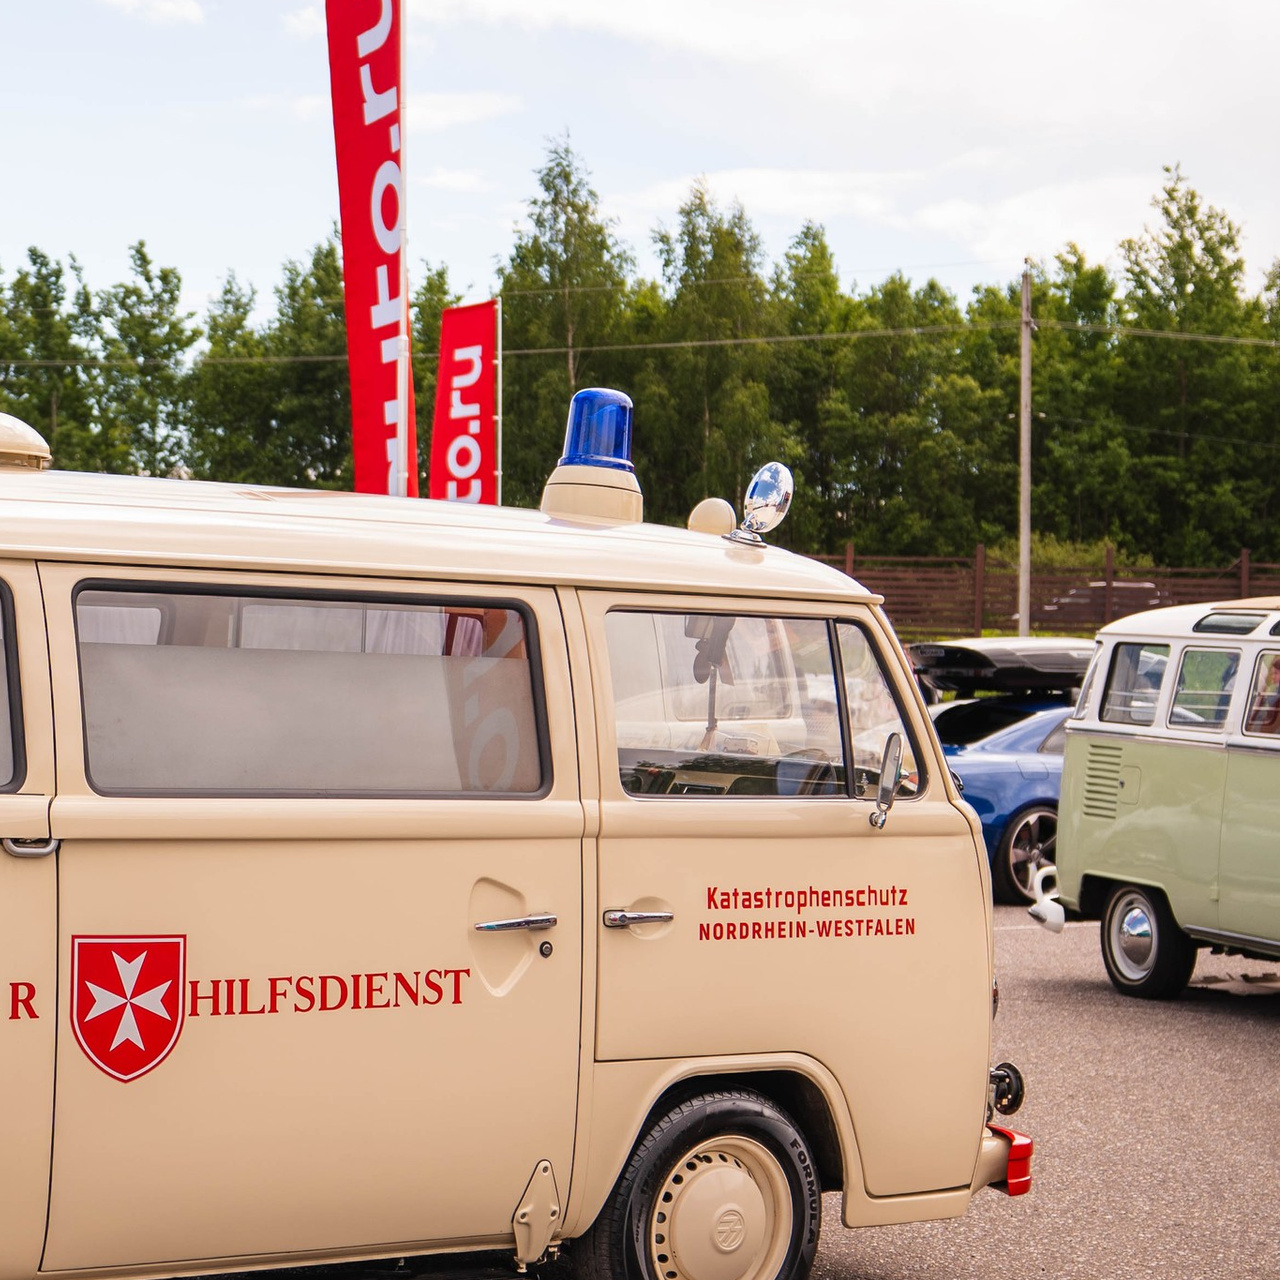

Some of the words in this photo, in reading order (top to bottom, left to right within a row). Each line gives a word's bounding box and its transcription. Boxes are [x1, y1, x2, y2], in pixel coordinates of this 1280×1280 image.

[706, 884, 908, 915] Katastrophenschutz
[698, 918, 916, 941] NORDRHEIN-WESTFALEN
[188, 968, 472, 1018] HILFSDIENST
[789, 1138, 818, 1245] FORMULA
